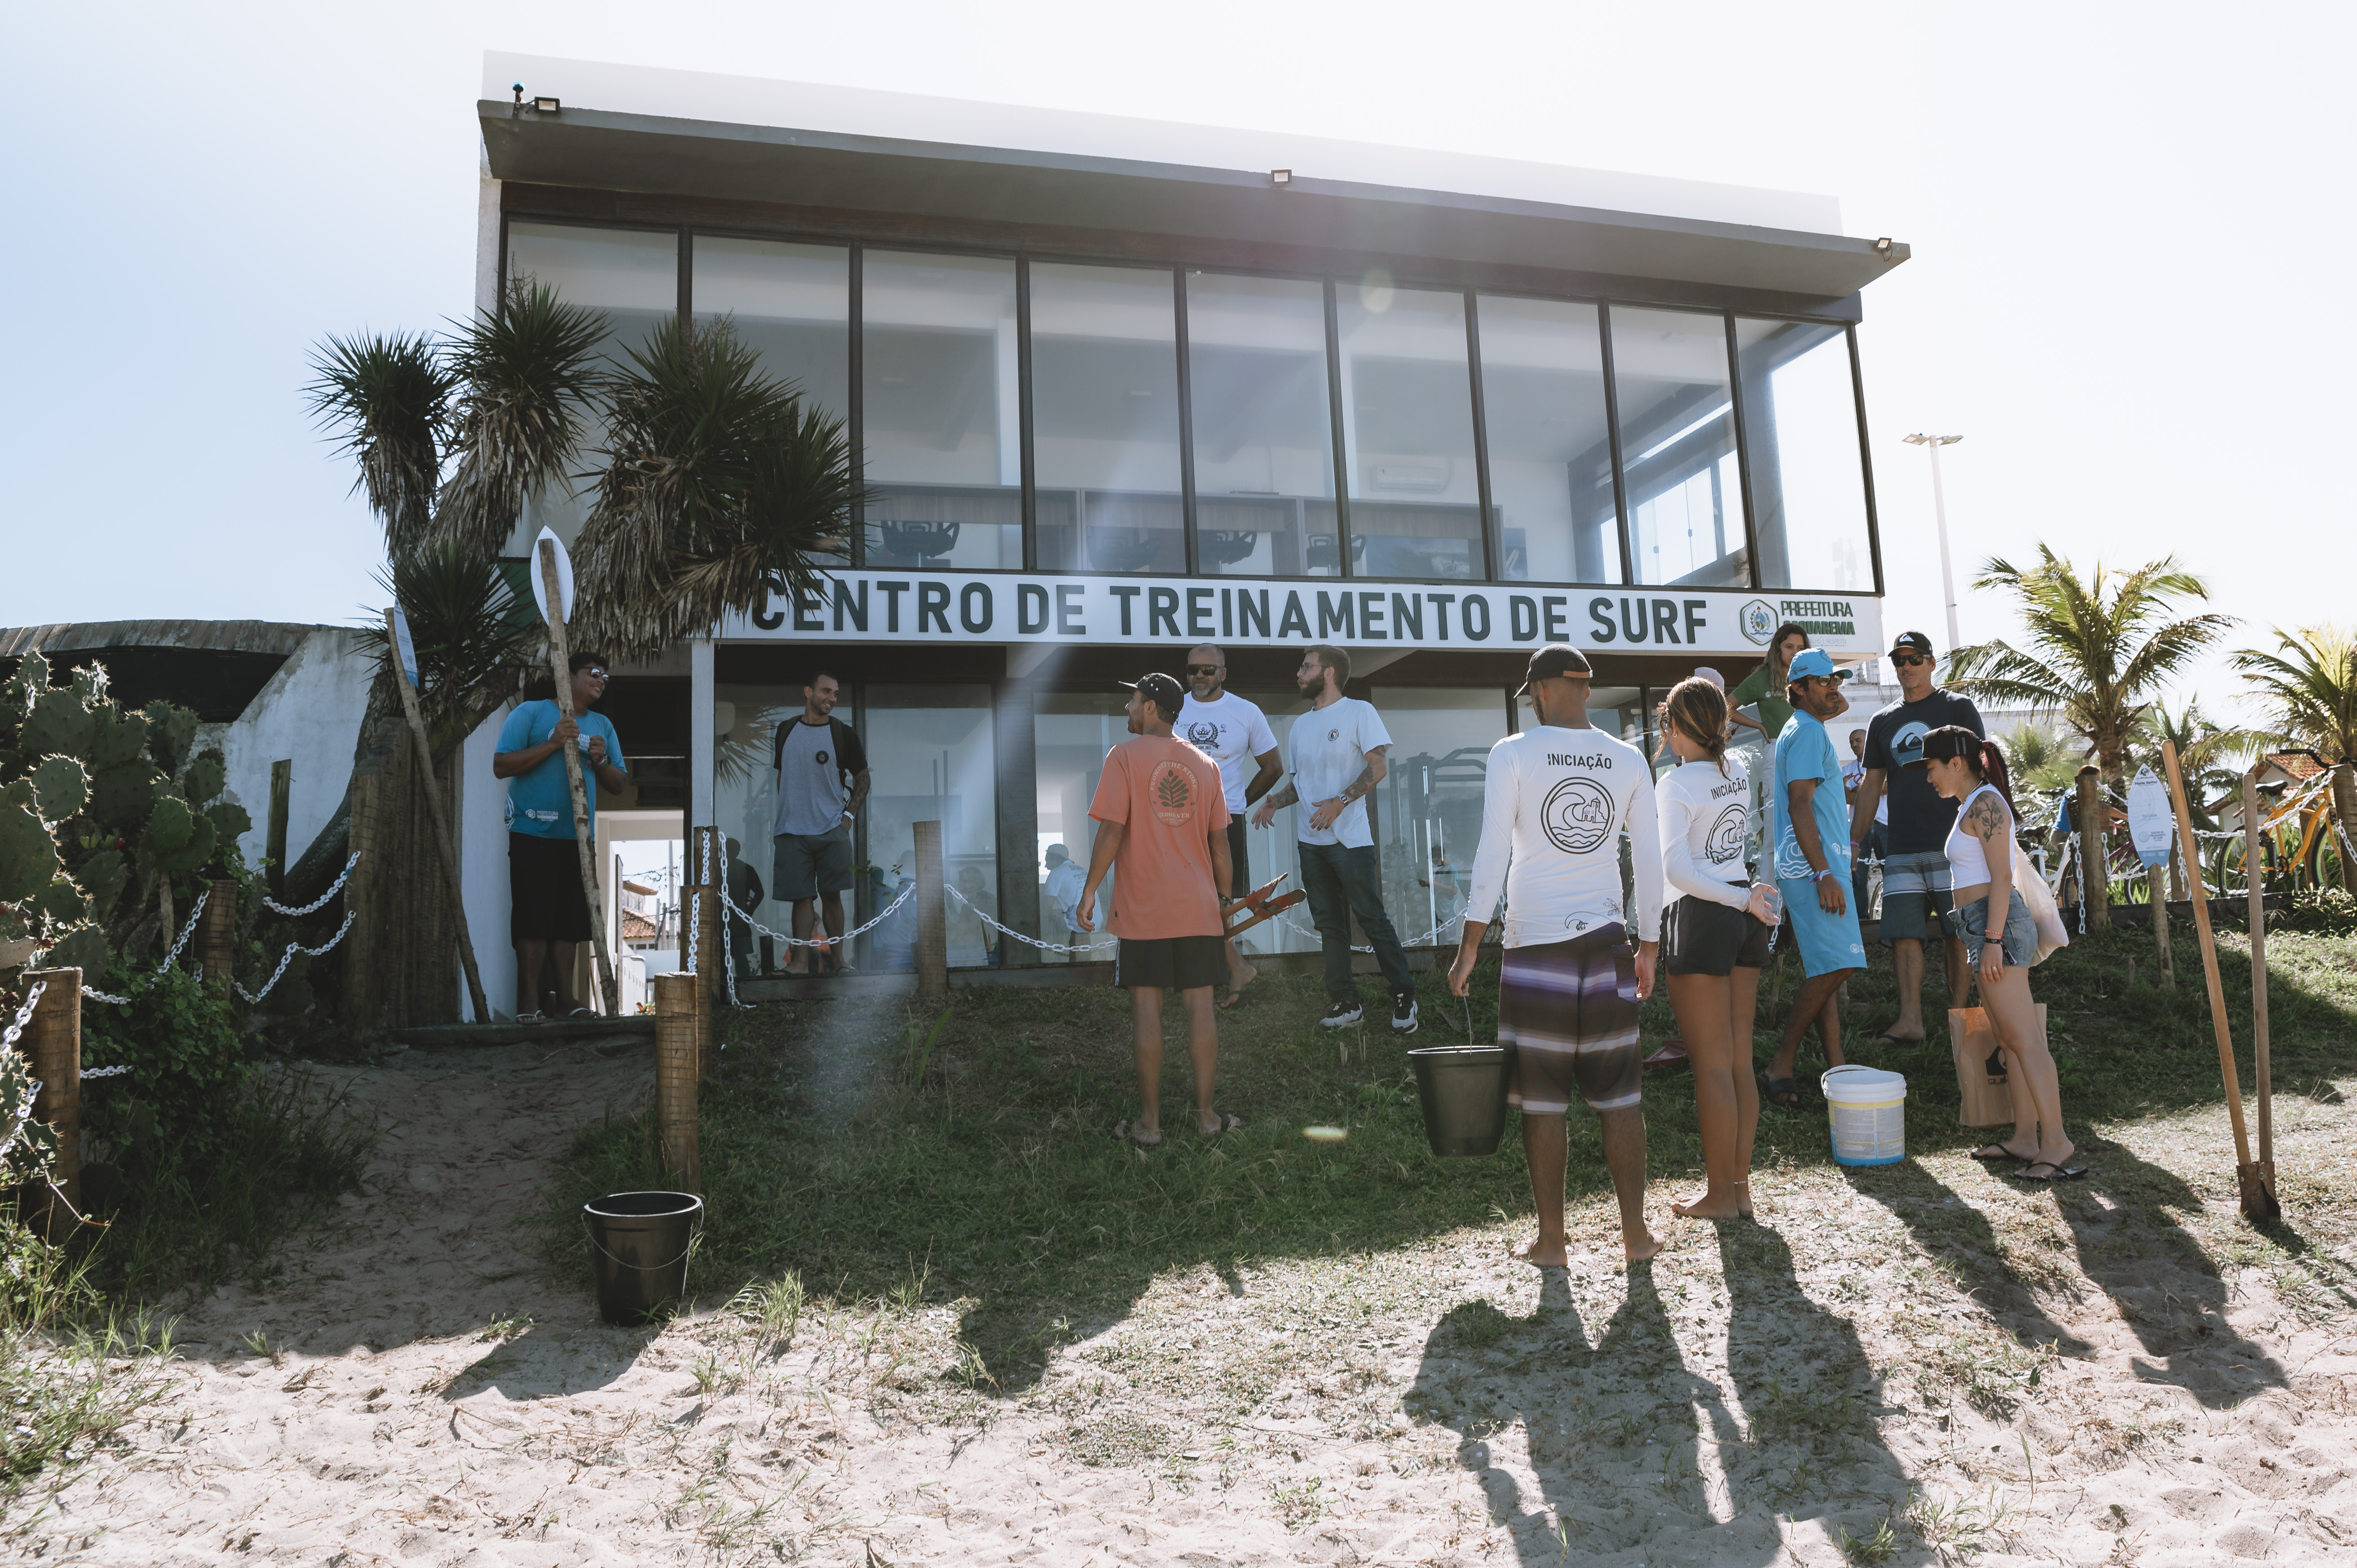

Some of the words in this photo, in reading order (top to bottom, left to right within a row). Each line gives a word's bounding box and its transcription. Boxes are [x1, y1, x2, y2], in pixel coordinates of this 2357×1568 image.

[753, 578, 993, 633] CENTRO
[1018, 583, 1086, 634] DE
[1110, 585, 1489, 641] TREINAMENTO
[1511, 596, 1570, 642] DE
[1590, 597, 1707, 644] SURF
[1781, 601, 1853, 617] PREFEITURA
[1784, 620, 1855, 635] QUAREMA
[1548, 753, 1612, 770] INICIAÇÃO
[1150, 762, 1167, 791] PROMOTE
[1183, 766, 1197, 790] STOKE
[1711, 778, 1747, 800] INICIAÇÃO
